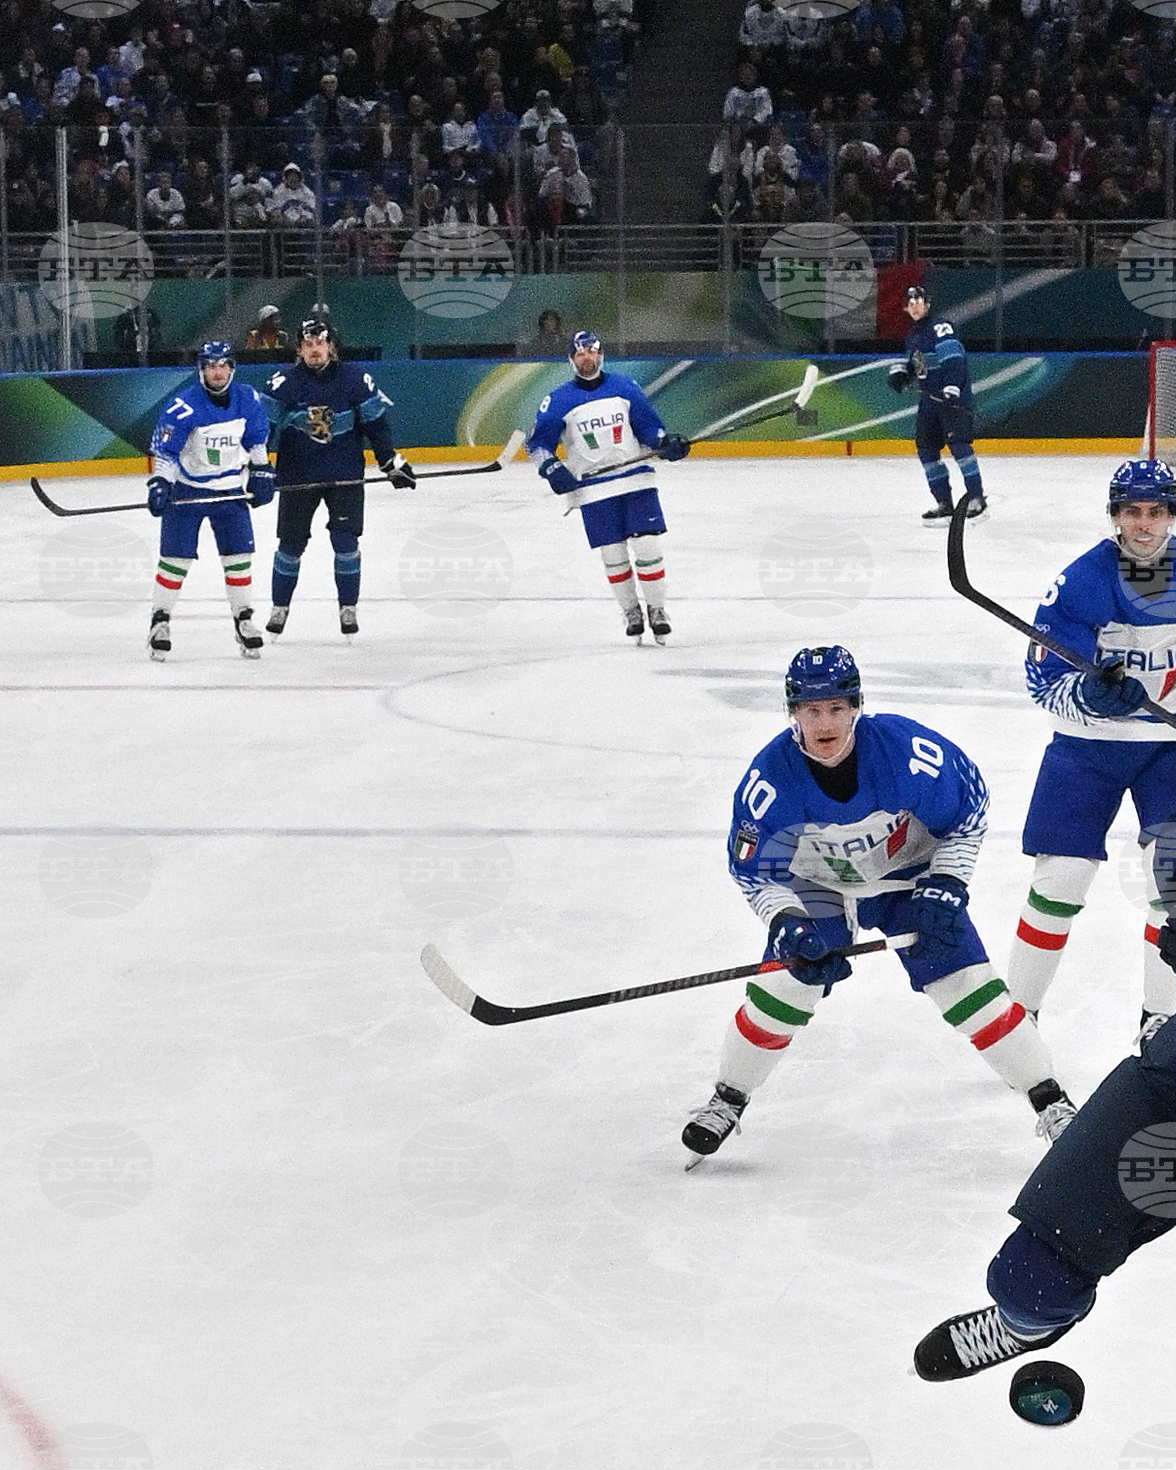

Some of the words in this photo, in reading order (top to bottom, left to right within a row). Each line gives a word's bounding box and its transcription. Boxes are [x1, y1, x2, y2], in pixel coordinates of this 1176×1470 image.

[166, 397, 194, 420] 77
[577, 412, 624, 433] ITALIA
[909, 736, 943, 778] 10
[742, 768, 777, 820] 10
[911, 886, 961, 907] CCM
